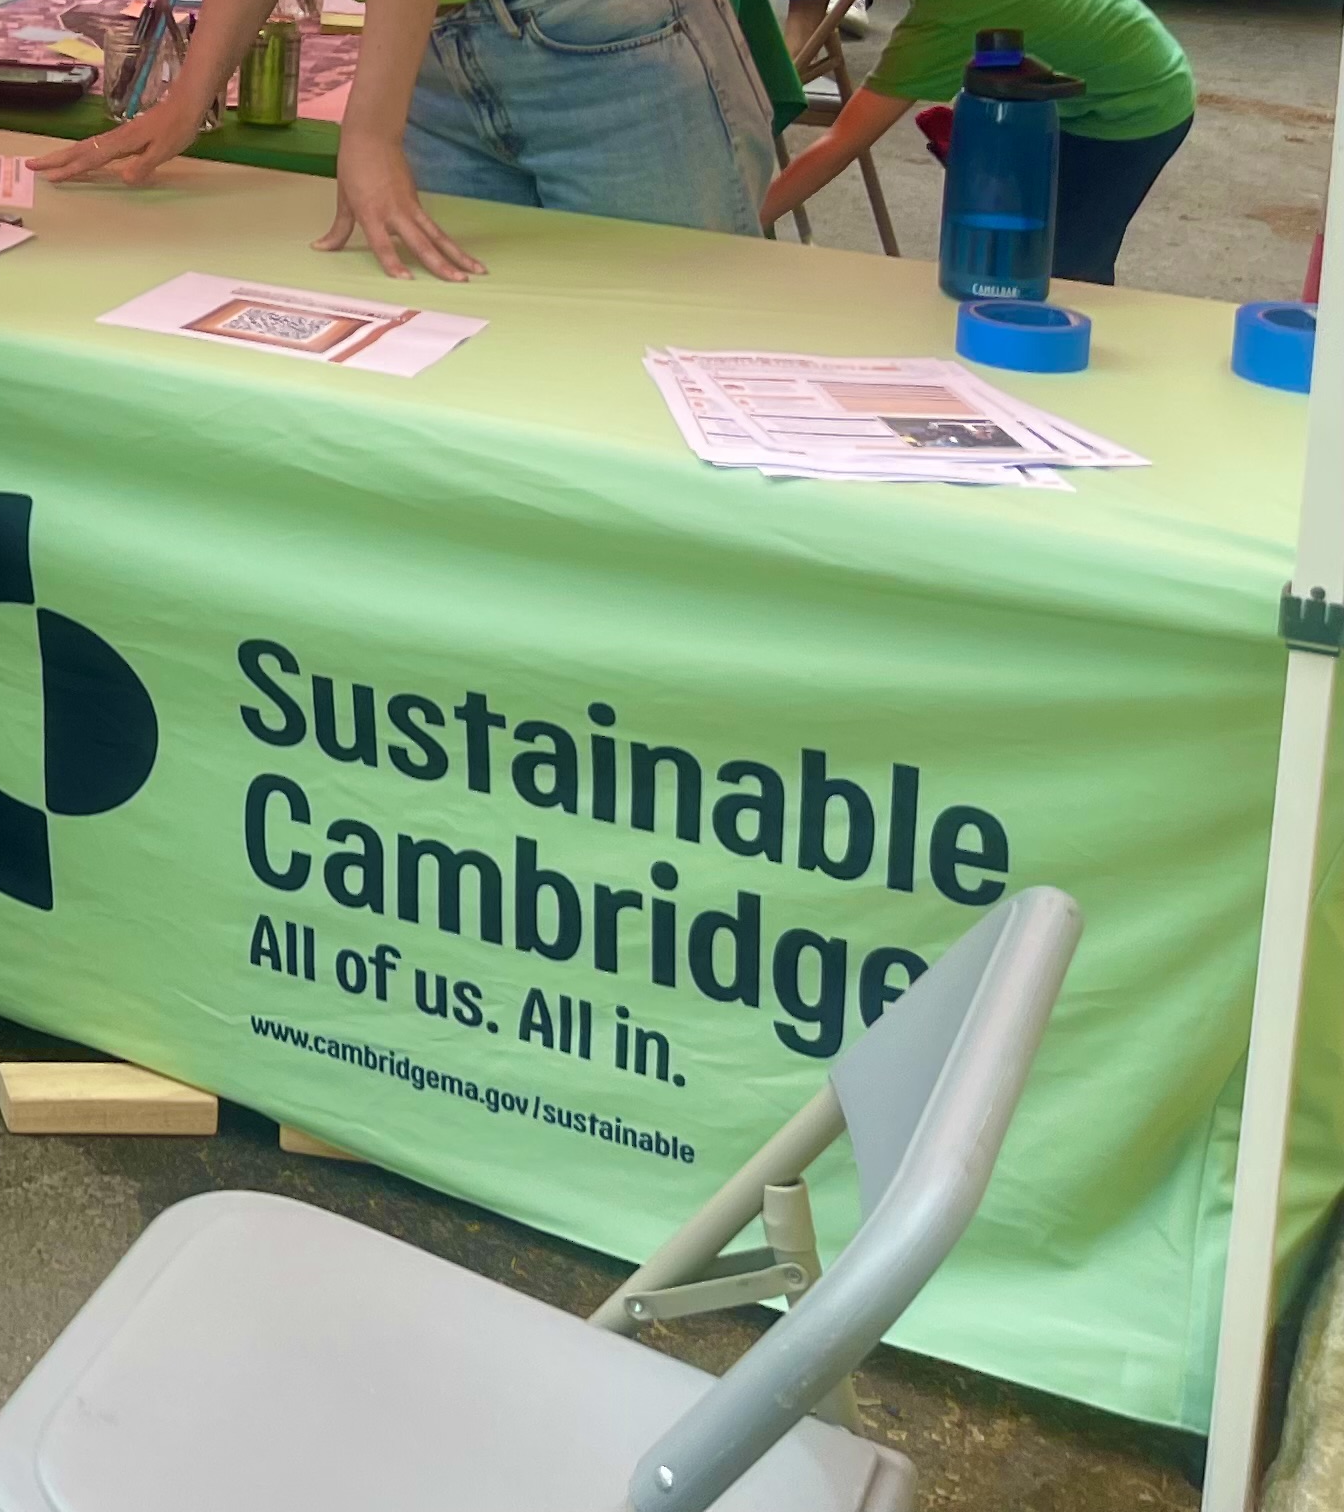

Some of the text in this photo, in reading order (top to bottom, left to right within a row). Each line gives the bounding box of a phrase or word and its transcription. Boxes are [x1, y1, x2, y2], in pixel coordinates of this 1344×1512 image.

[237, 638, 1010, 906] Sustainable
[244, 773, 928, 1059] Cambridge
[250, 914, 687, 1088] All of us. All in.
[250, 1014, 696, 1165] www.cambridgema.gov/sustainable
